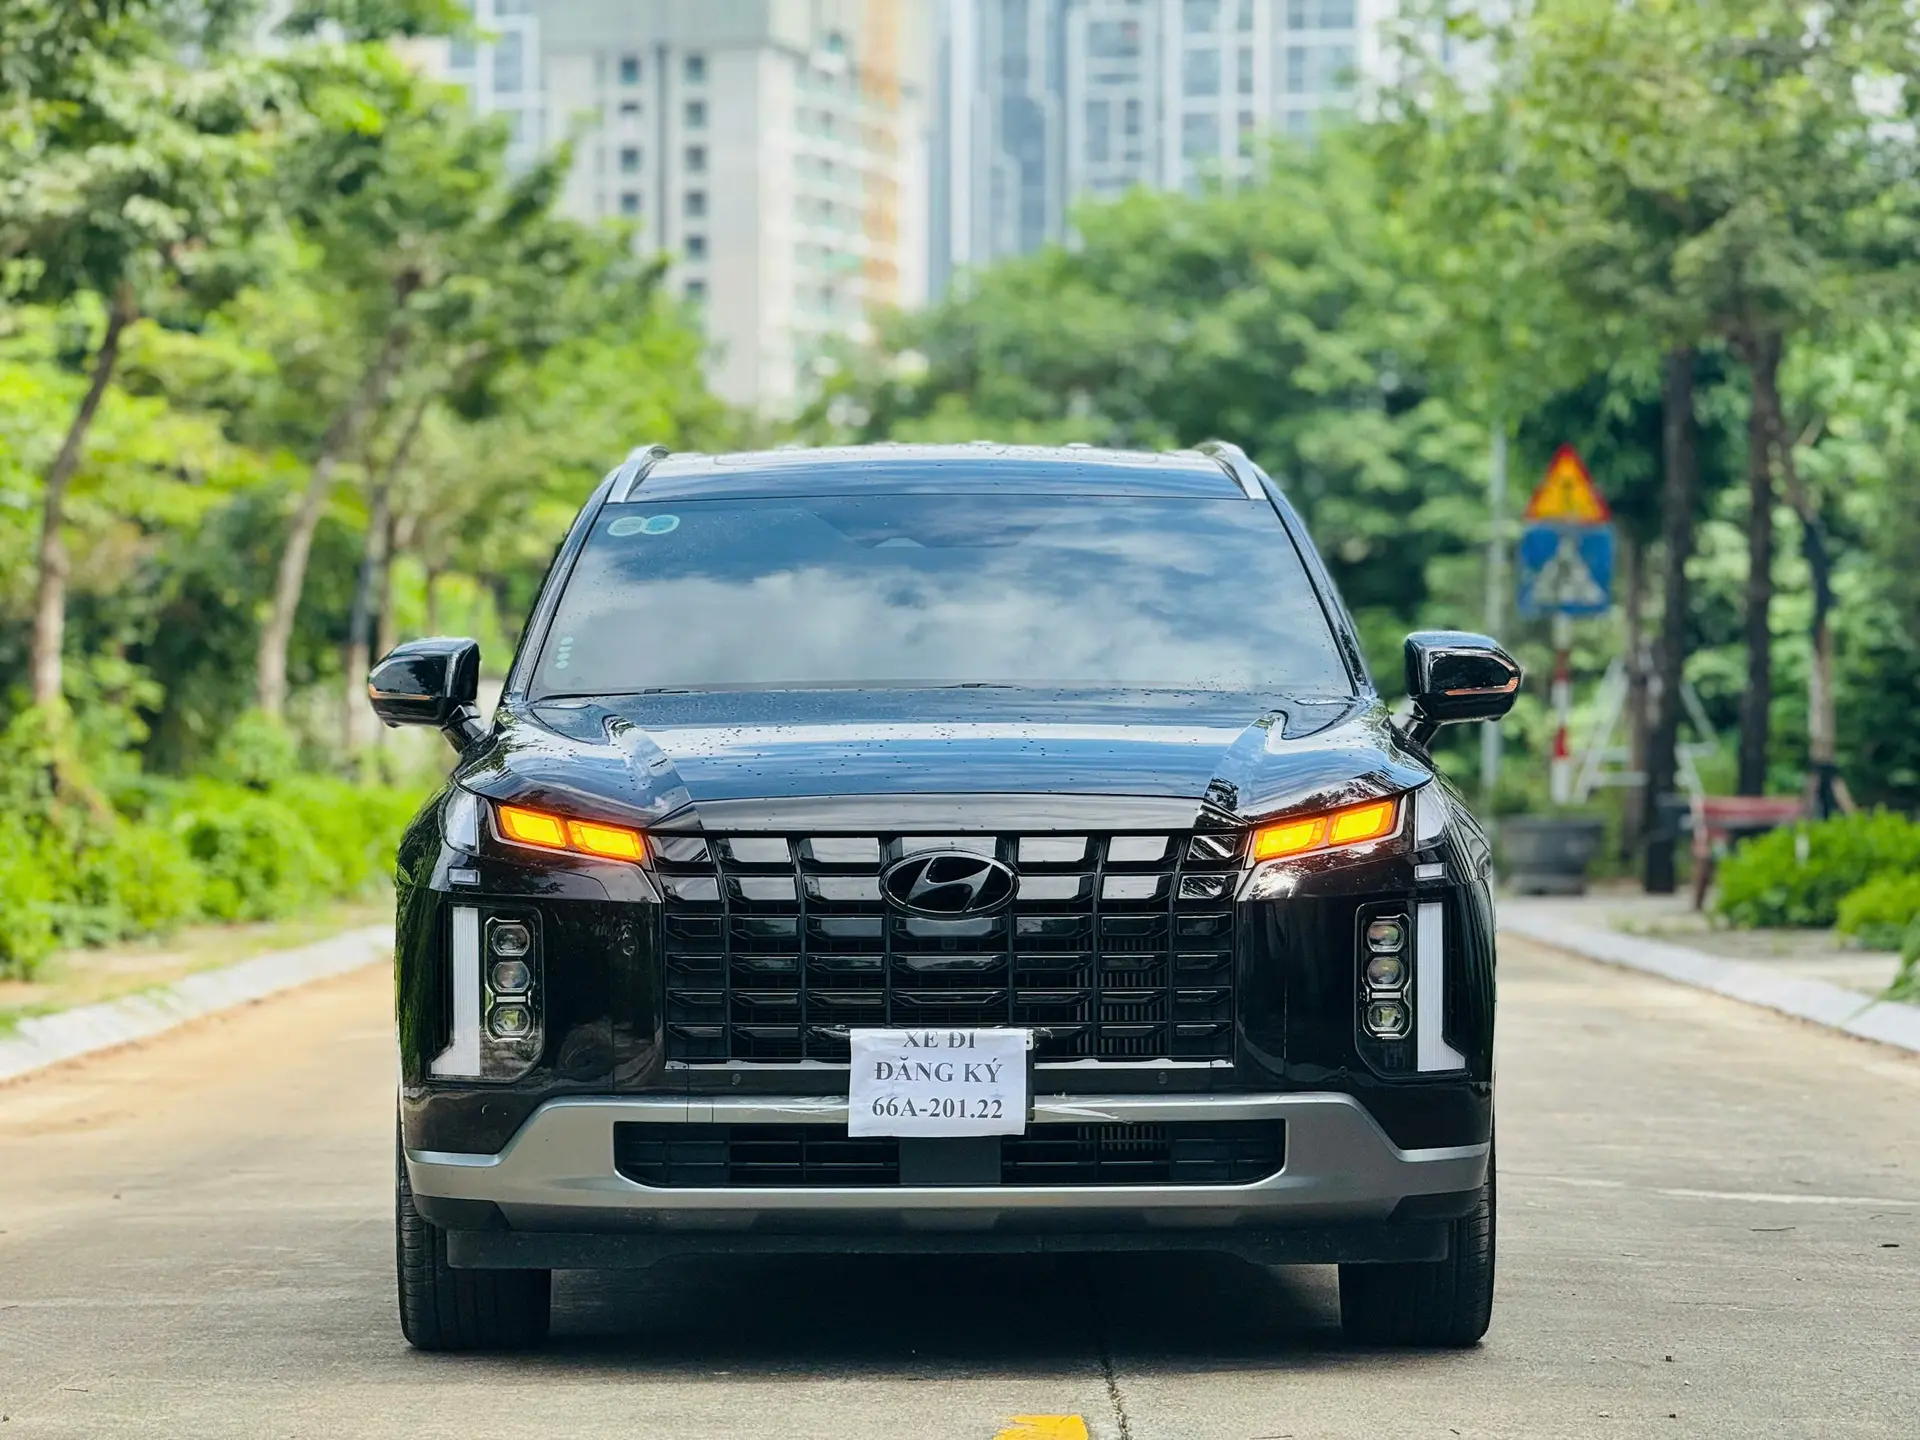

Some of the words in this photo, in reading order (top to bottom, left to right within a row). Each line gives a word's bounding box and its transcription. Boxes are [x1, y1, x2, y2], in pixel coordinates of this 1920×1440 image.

[903, 1031, 939, 1048] XE
[874, 1056, 954, 1083] ĐĂNG
[964, 1058, 1003, 1083] KÝ
[872, 1096, 1003, 1119] 66A-201.22
